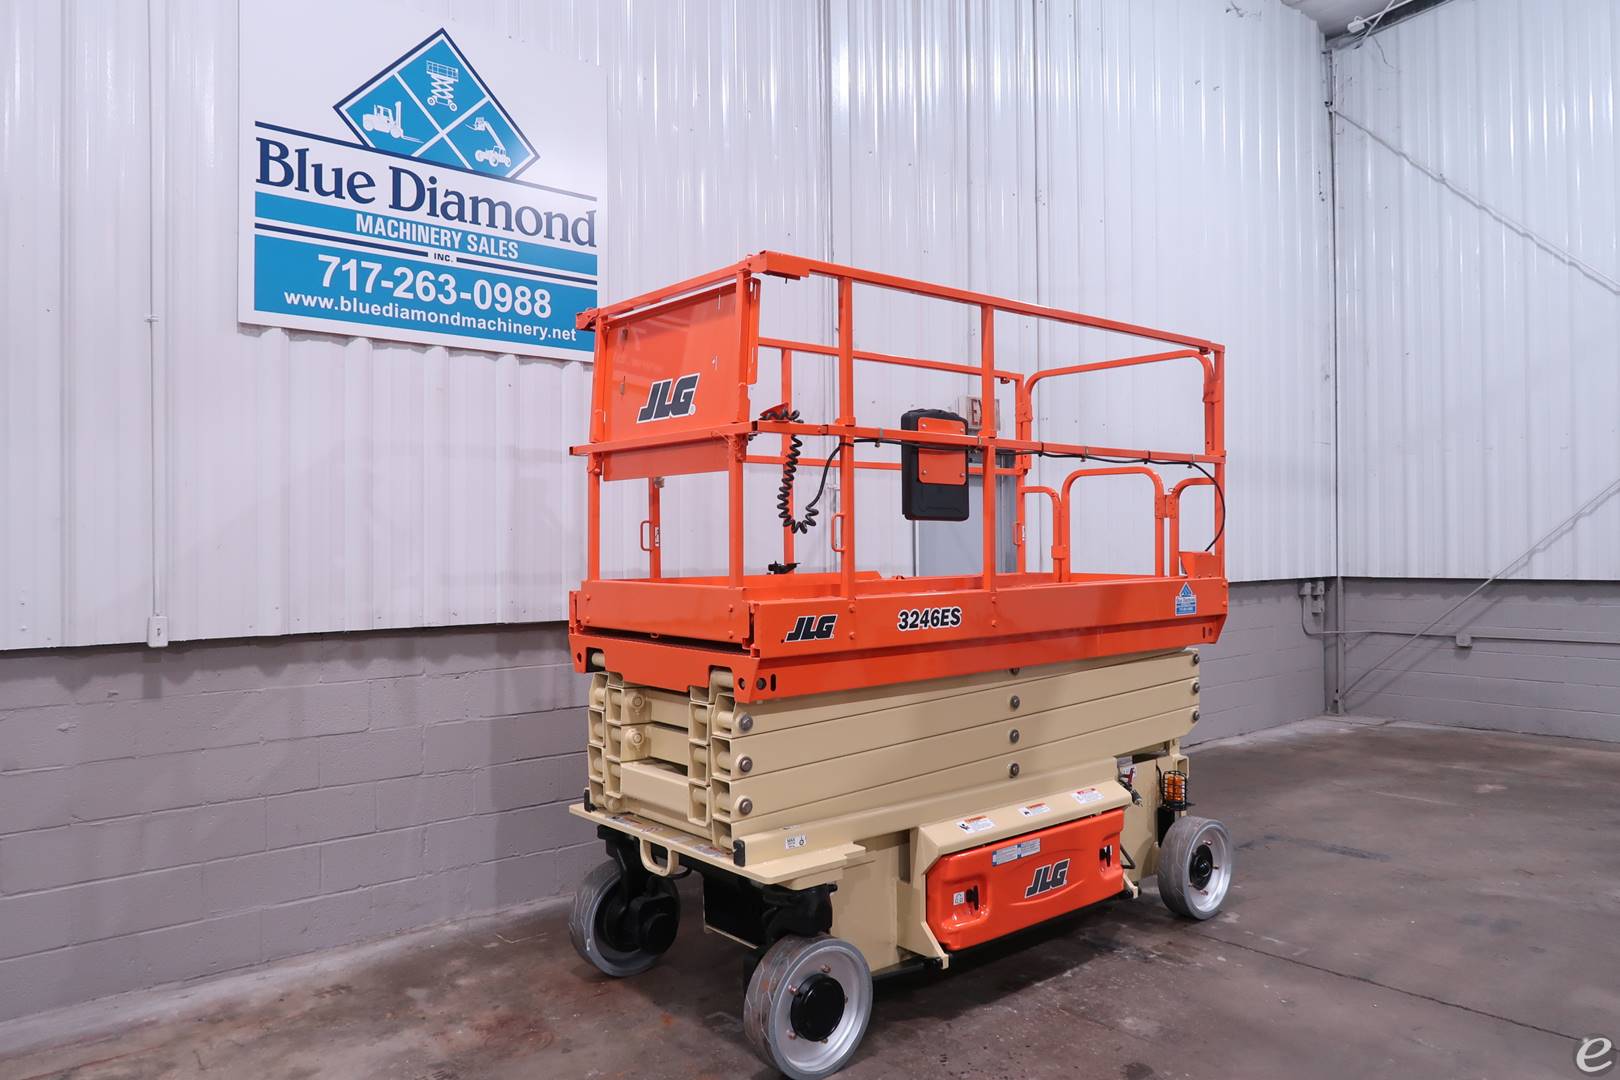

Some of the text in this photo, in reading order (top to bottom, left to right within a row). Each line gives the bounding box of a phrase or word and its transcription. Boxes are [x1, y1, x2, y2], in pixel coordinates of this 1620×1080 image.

[256, 137, 597, 248] Blue Diamond
[355, 213, 519, 259] MACHINERY SALES
[433, 252, 454, 263] INC.
[318, 254, 551, 319] 717-263-0988
[284, 290, 577, 342] www.bluediamondmachinery.net
[637, 373, 700, 424] JLG
[785, 614, 838, 642] JLG
[897, 606, 963, 632] 3246ES
[1025, 859, 1071, 899] JLG
